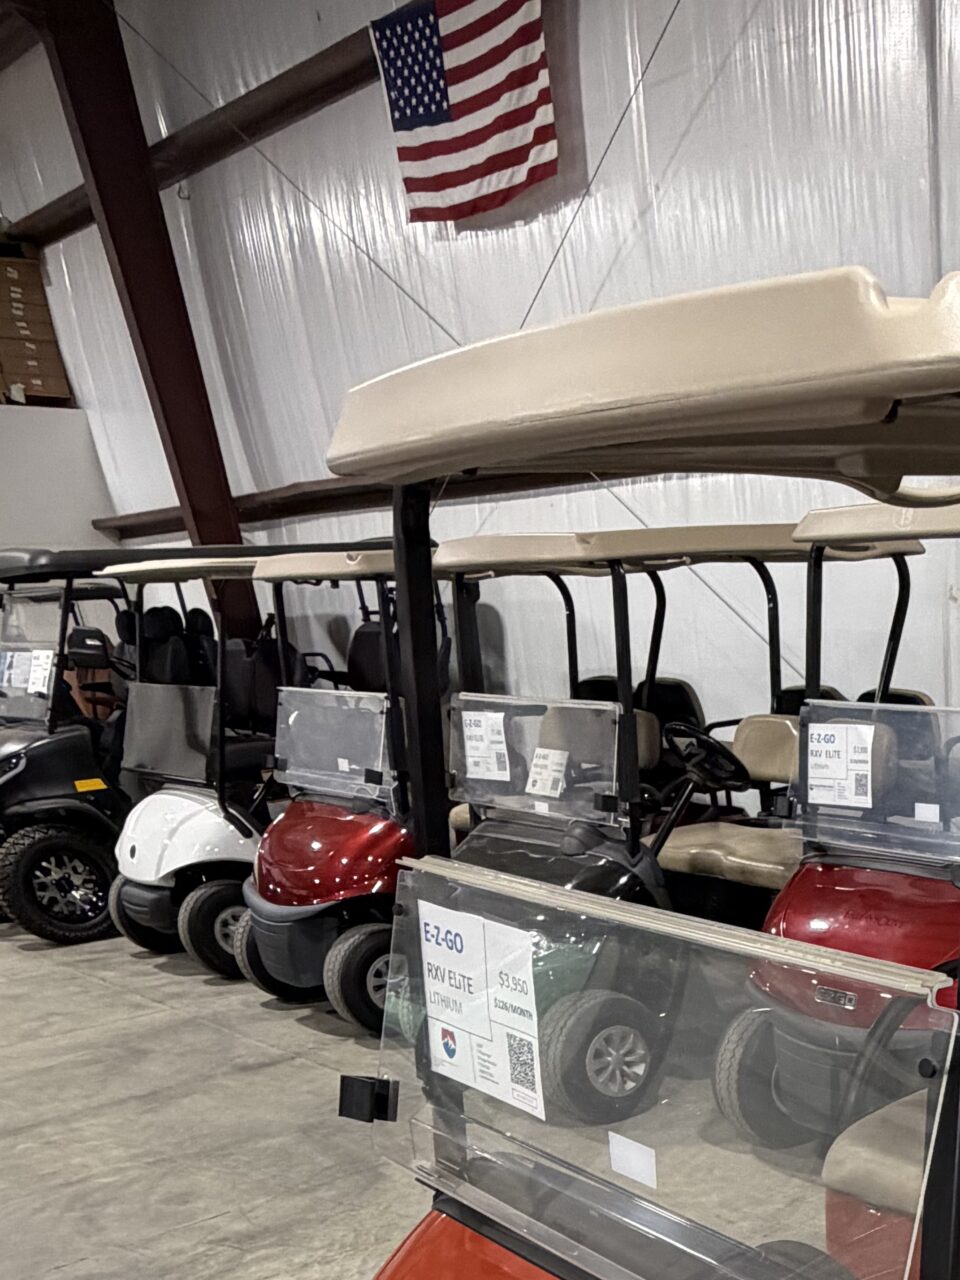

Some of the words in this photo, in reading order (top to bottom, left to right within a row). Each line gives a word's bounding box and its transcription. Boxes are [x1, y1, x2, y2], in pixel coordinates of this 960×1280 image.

[810, 733, 836, 744] E-Z-GO
[424, 922, 464, 954] E-Z-GO
[427, 962, 446, 983] RXV
[499, 970, 528, 995] $3,950
[429, 991, 463, 1014] LITHIUM
